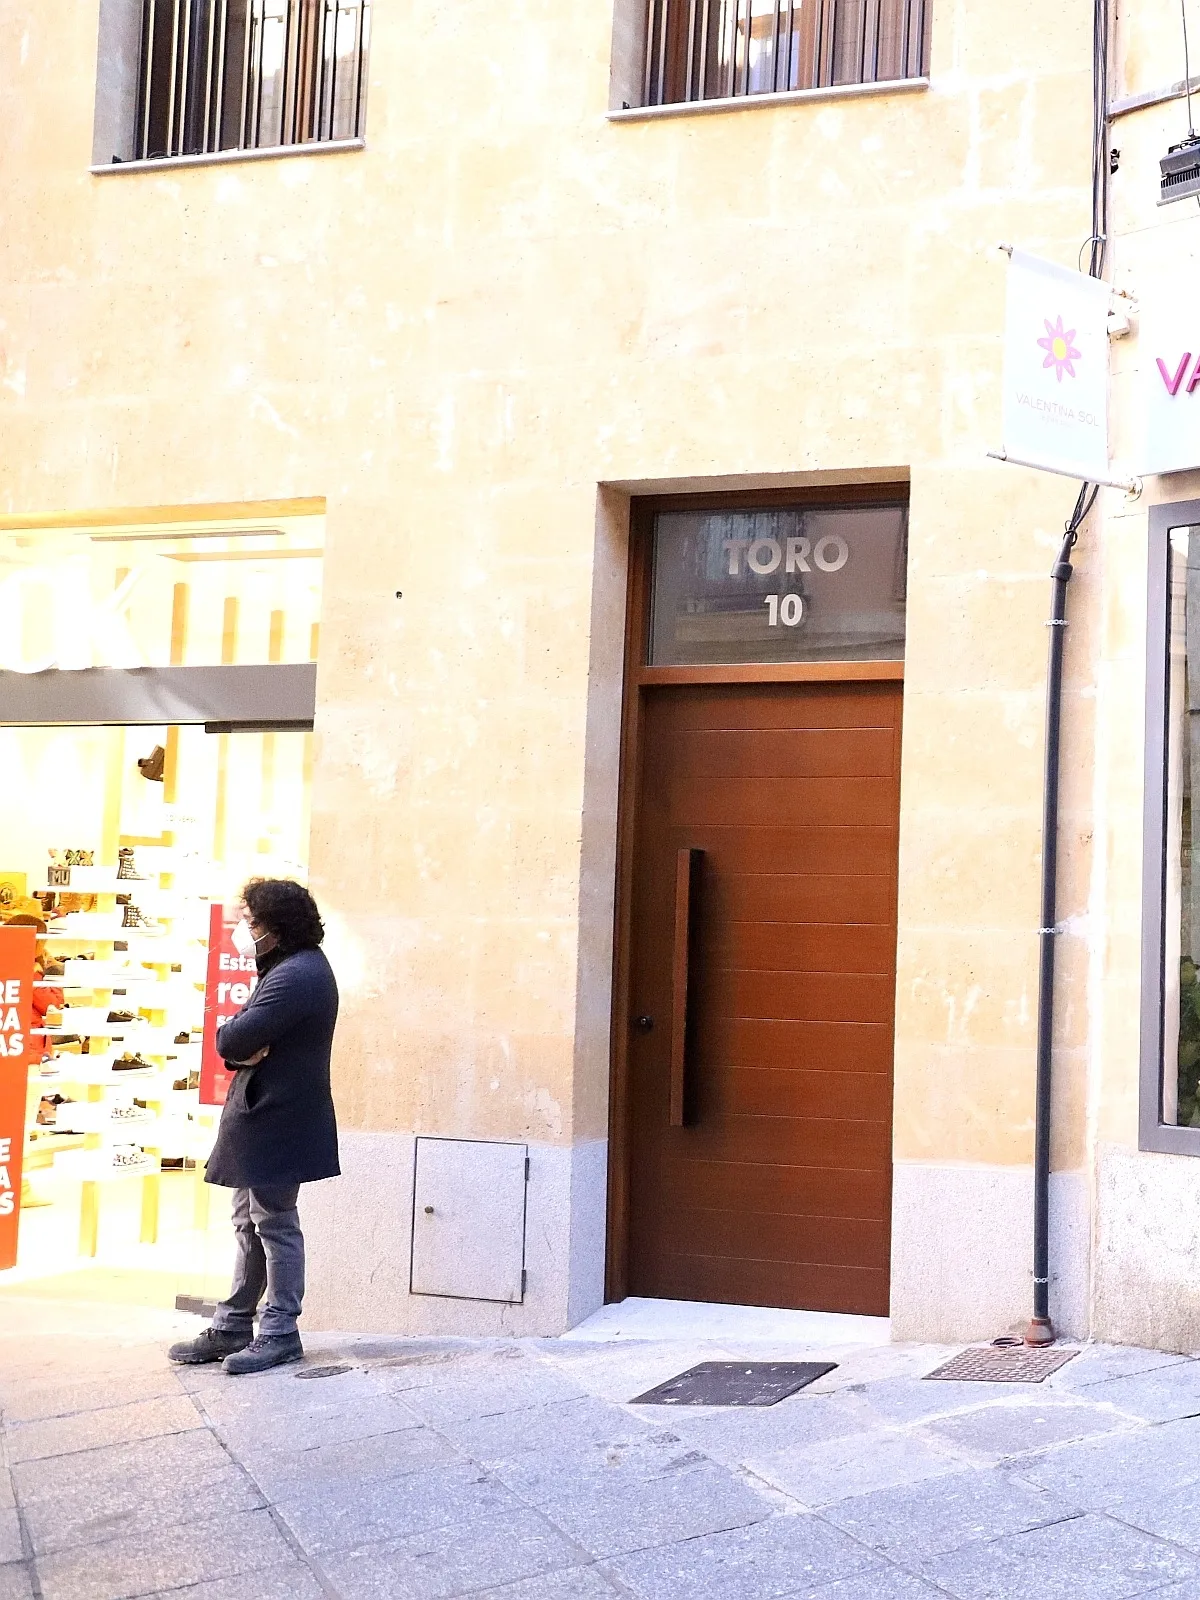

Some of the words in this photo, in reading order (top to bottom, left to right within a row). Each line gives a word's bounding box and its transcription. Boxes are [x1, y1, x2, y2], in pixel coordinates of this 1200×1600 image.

[1014, 391, 1075, 419] VALENTINA
[1077, 409, 1100, 428] SOL
[722, 534, 849, 575] TORO
[763, 593, 804, 627] 10
